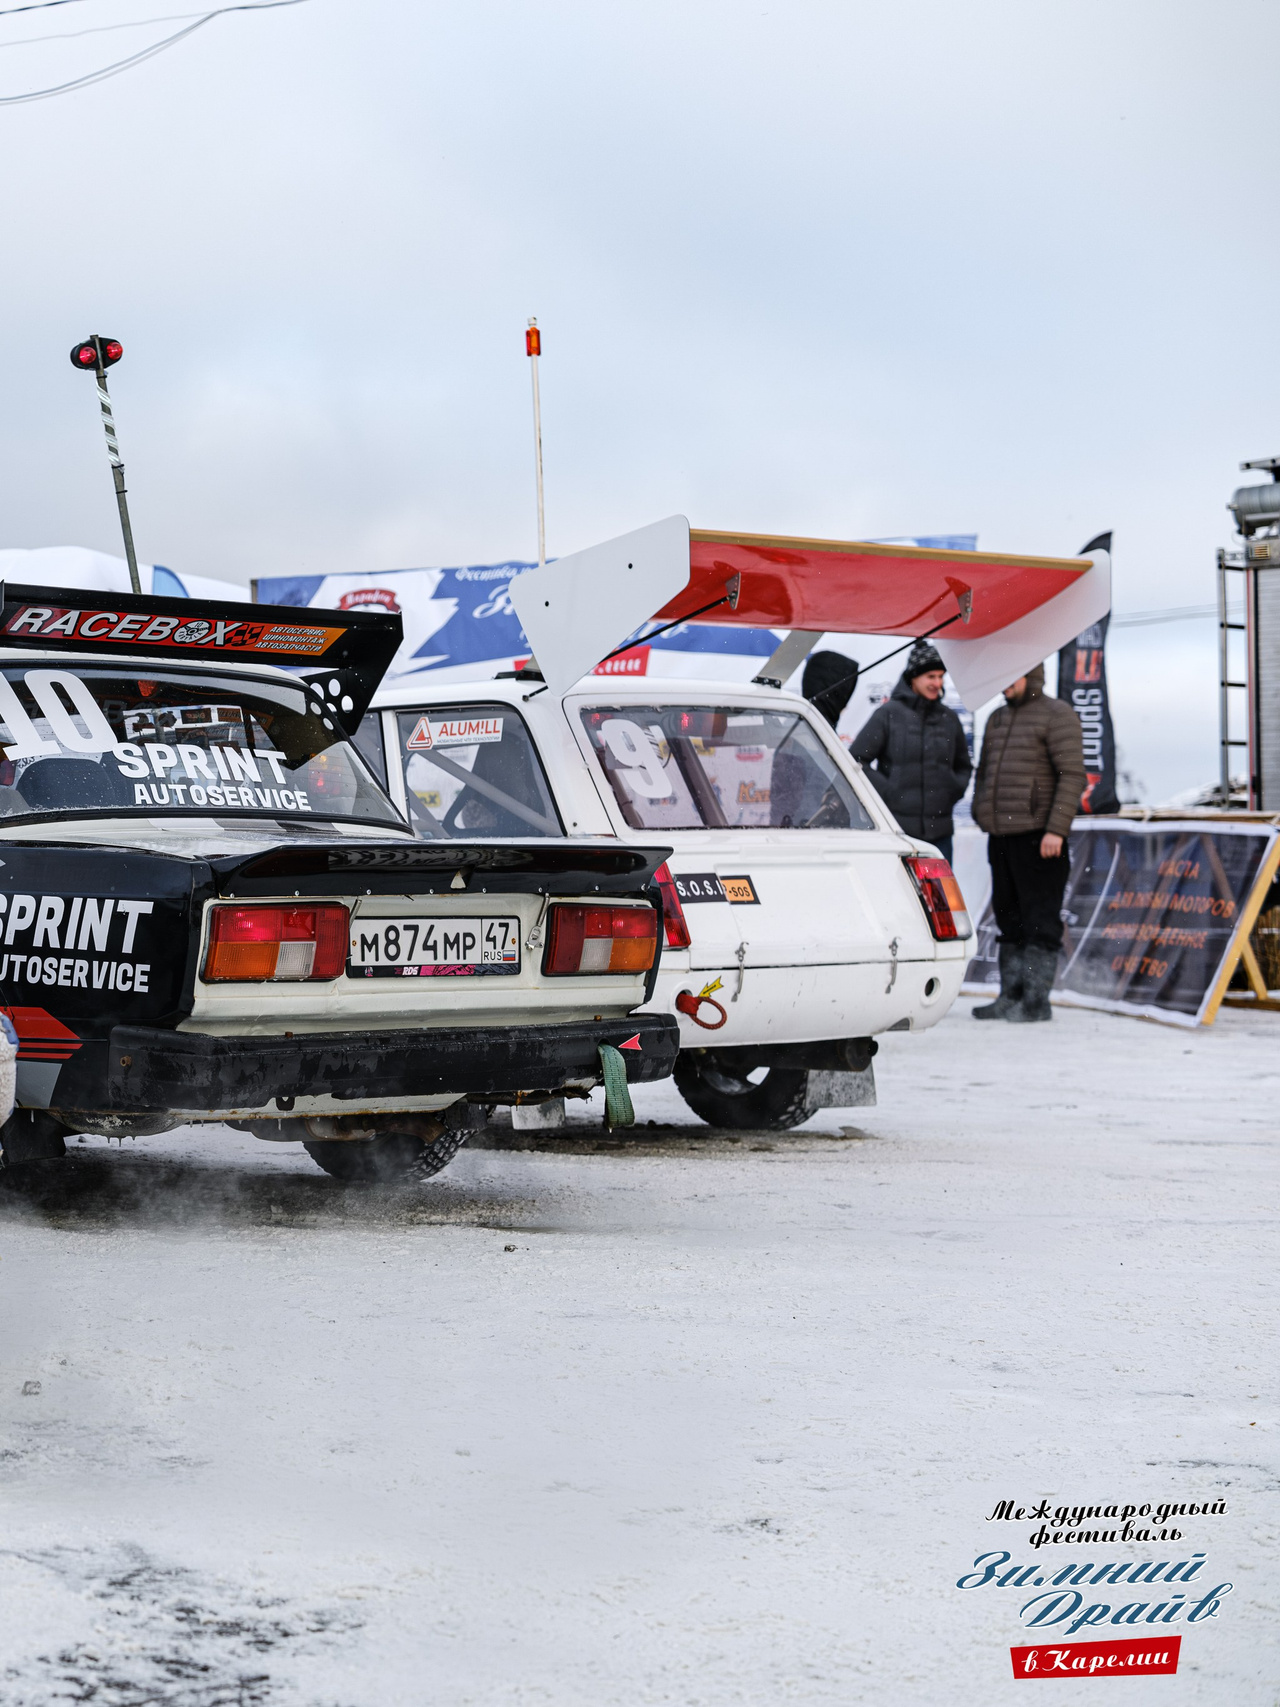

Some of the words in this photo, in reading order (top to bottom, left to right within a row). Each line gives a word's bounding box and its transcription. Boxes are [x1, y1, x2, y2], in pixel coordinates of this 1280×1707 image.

[262, 634, 328, 644] ШИНОМОНТАЖ
[269, 626, 327, 636] АВТОСЕРВИС
[254, 641, 323, 652] АВТОЗАПЧАСТИ
[113, 743, 288, 785] SPRINT
[601, 719, 673, 798] 9
[134, 784, 312, 811] AUTOSERVICE
[485, 922, 509, 950] 47
[483, 952, 502, 961] RUS
